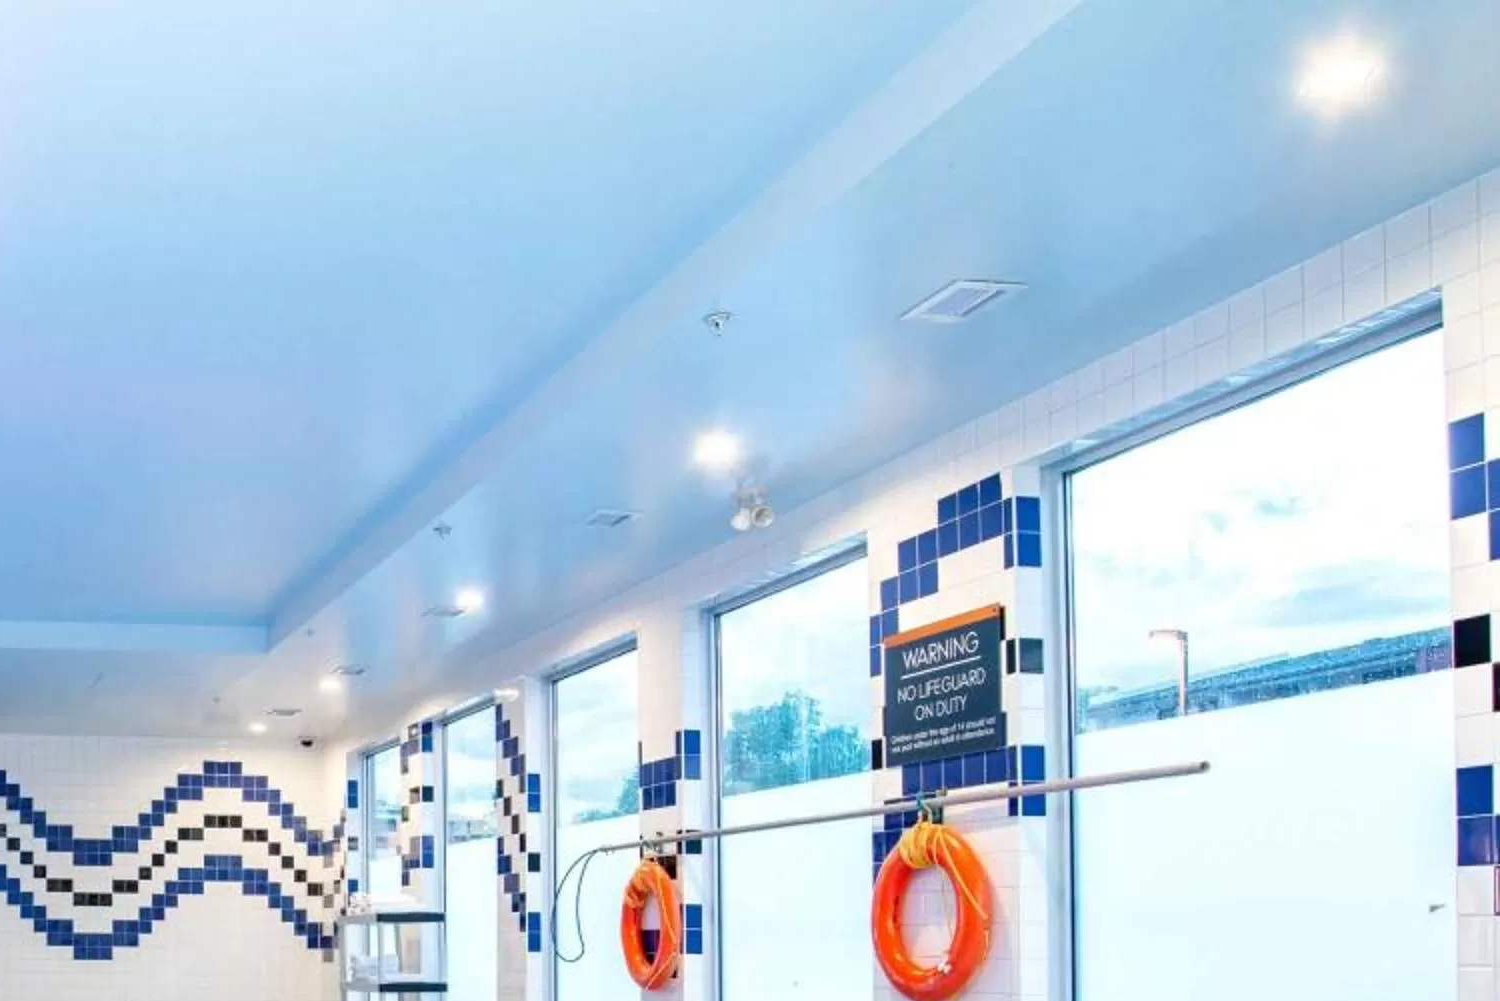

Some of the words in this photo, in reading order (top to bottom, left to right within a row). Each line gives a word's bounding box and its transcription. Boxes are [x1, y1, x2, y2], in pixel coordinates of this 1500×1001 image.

[902, 631, 980, 670] WARNING
[897, 685, 917, 704] NO
[918, 667, 987, 699] LIFEGUARD
[914, 704, 934, 721] ON
[936, 694, 967, 718] DUTY
